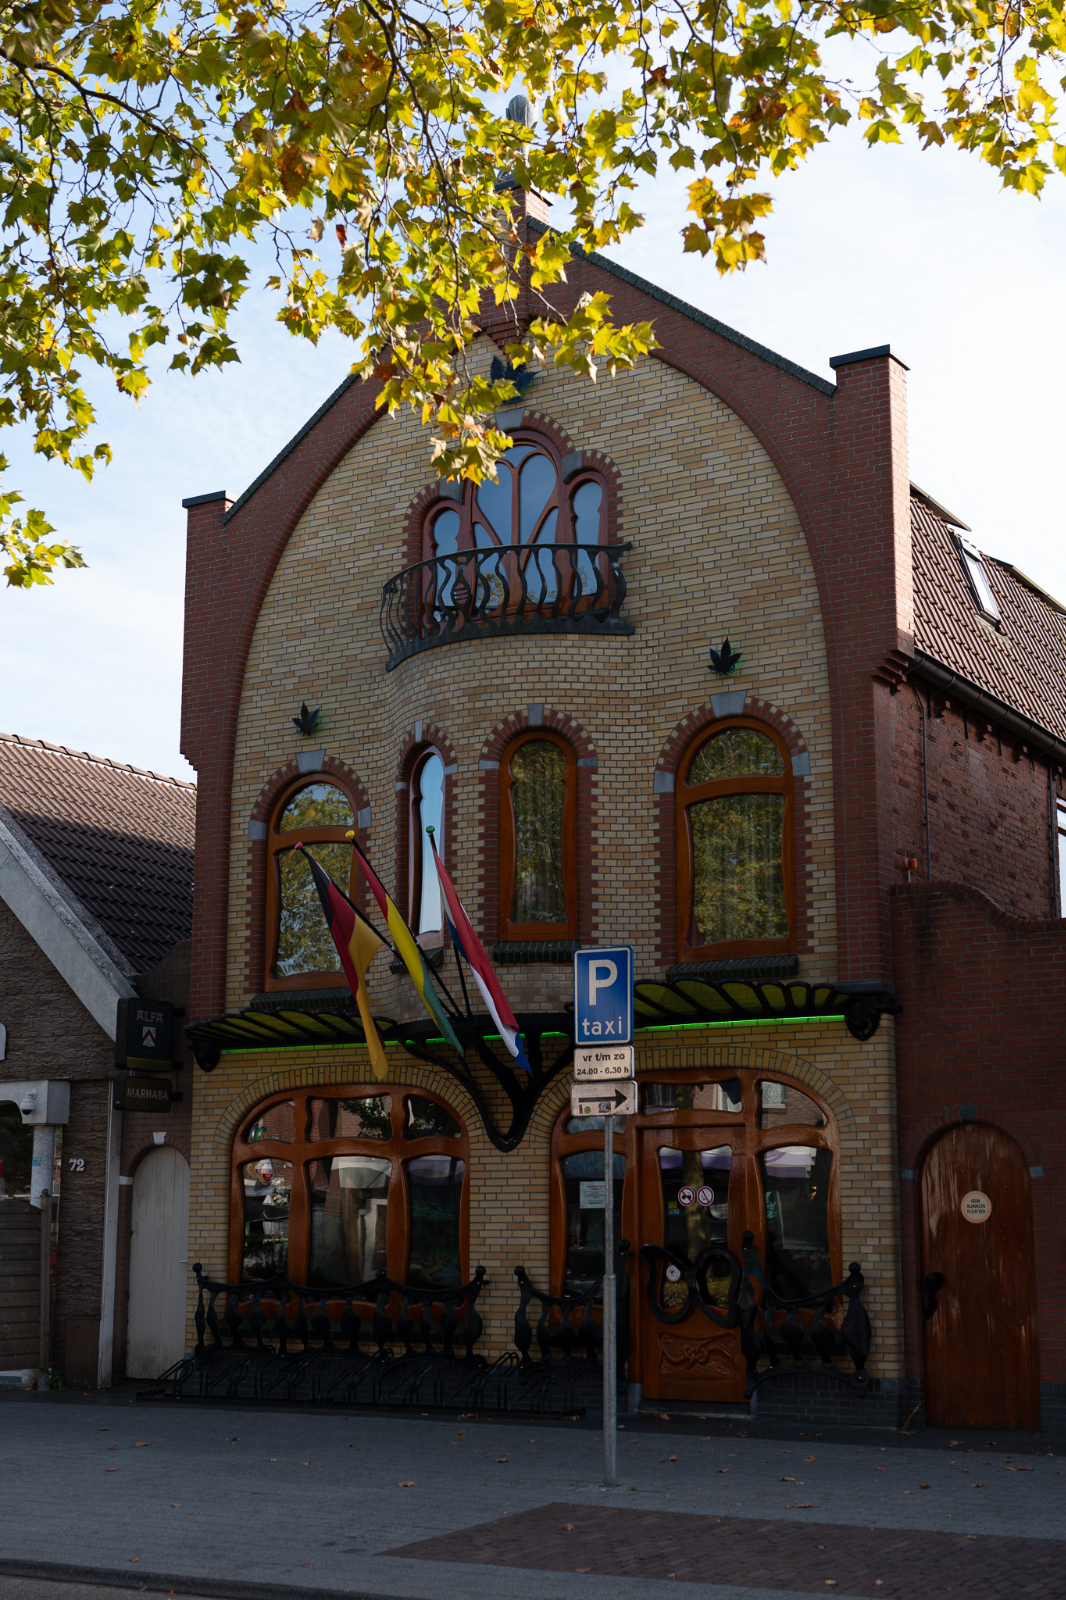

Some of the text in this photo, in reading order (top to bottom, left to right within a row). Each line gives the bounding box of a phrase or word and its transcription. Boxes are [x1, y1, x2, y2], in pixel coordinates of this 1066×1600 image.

[588, 959, 618, 1006] P
[136, 1009, 164, 1024] ALFA
[581, 1016, 622, 1036] taxi
[595, 1052, 611, 1062] t/m
[614, 1053, 625, 1061] zo
[576, 1068, 599, 1076] 24.00
[605, 1067, 622, 1075] 6.30
[624, 1066, 629, 1074] h
[127, 1087, 169, 1100] MARHABA
[68, 1158, 85, 1172] 72
